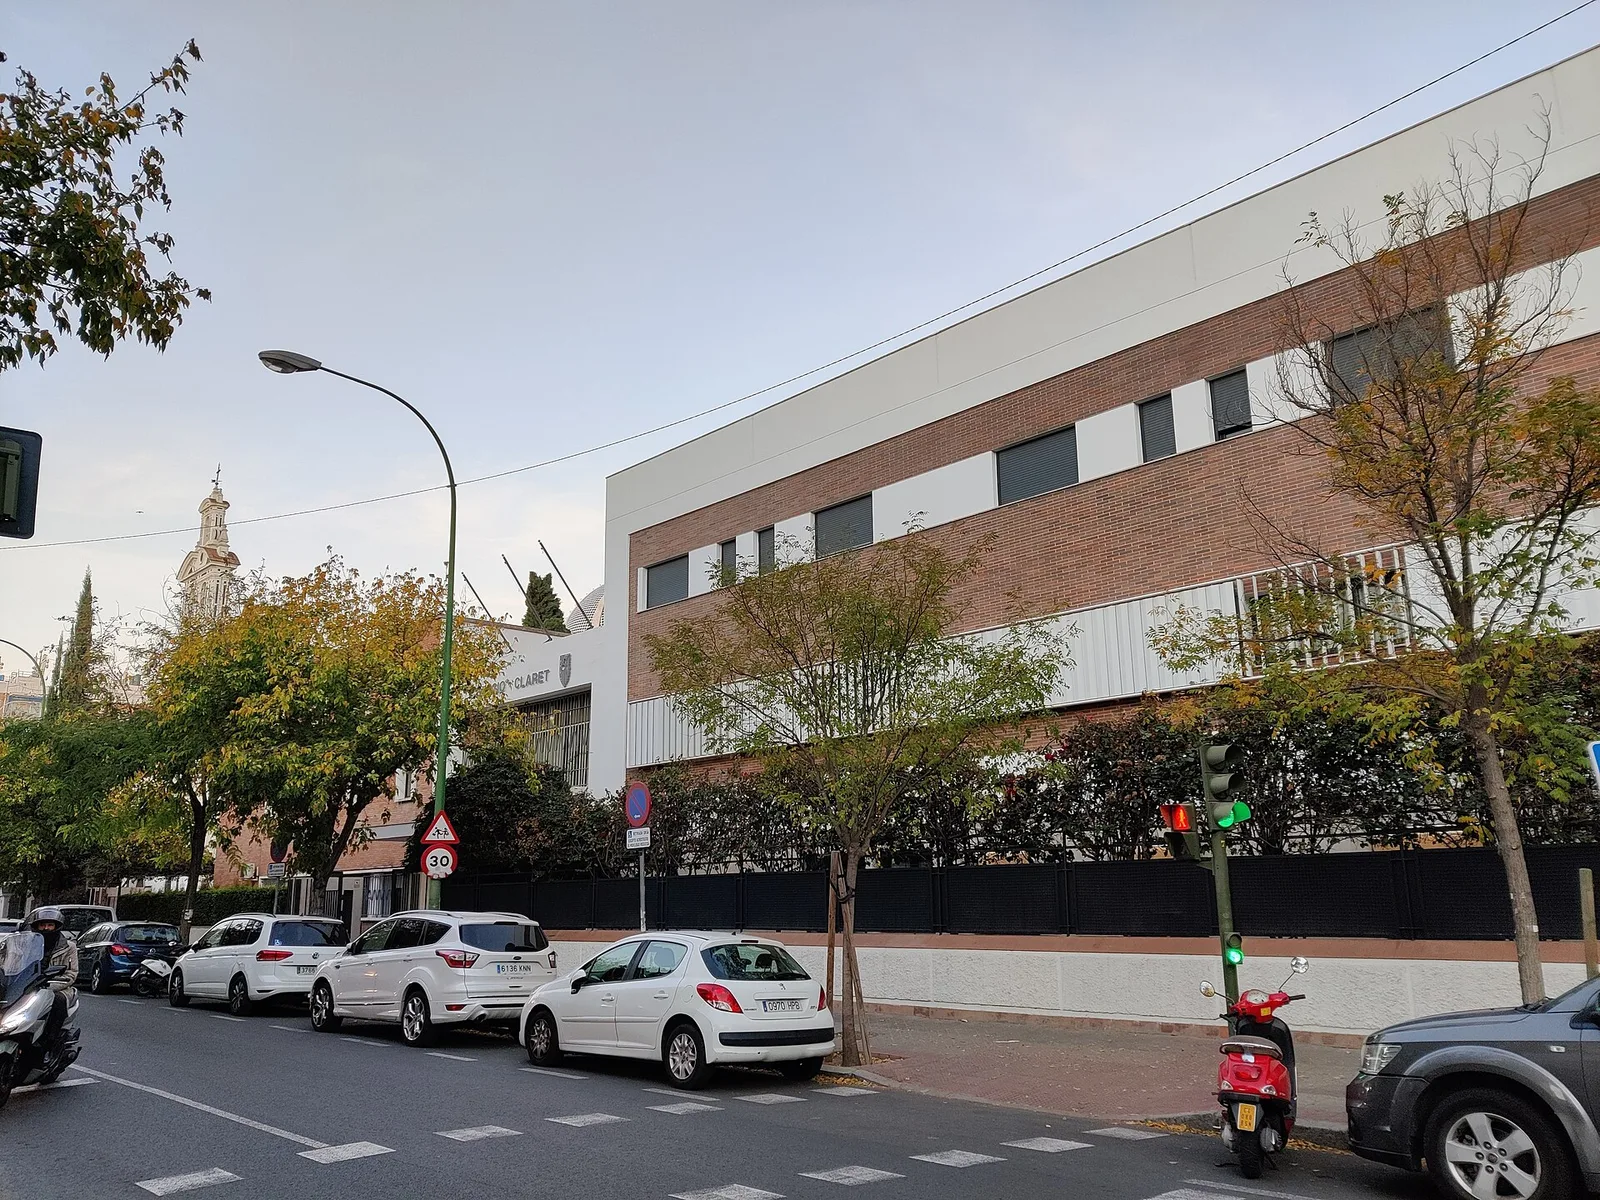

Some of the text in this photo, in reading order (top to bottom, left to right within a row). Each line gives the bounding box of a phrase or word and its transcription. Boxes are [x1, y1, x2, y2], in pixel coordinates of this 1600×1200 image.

[514, 669, 550, 689] CLARET
[430, 855, 450, 867] 30
[501, 964, 518, 973] 6136
[768, 1001, 786, 1011] 0970
